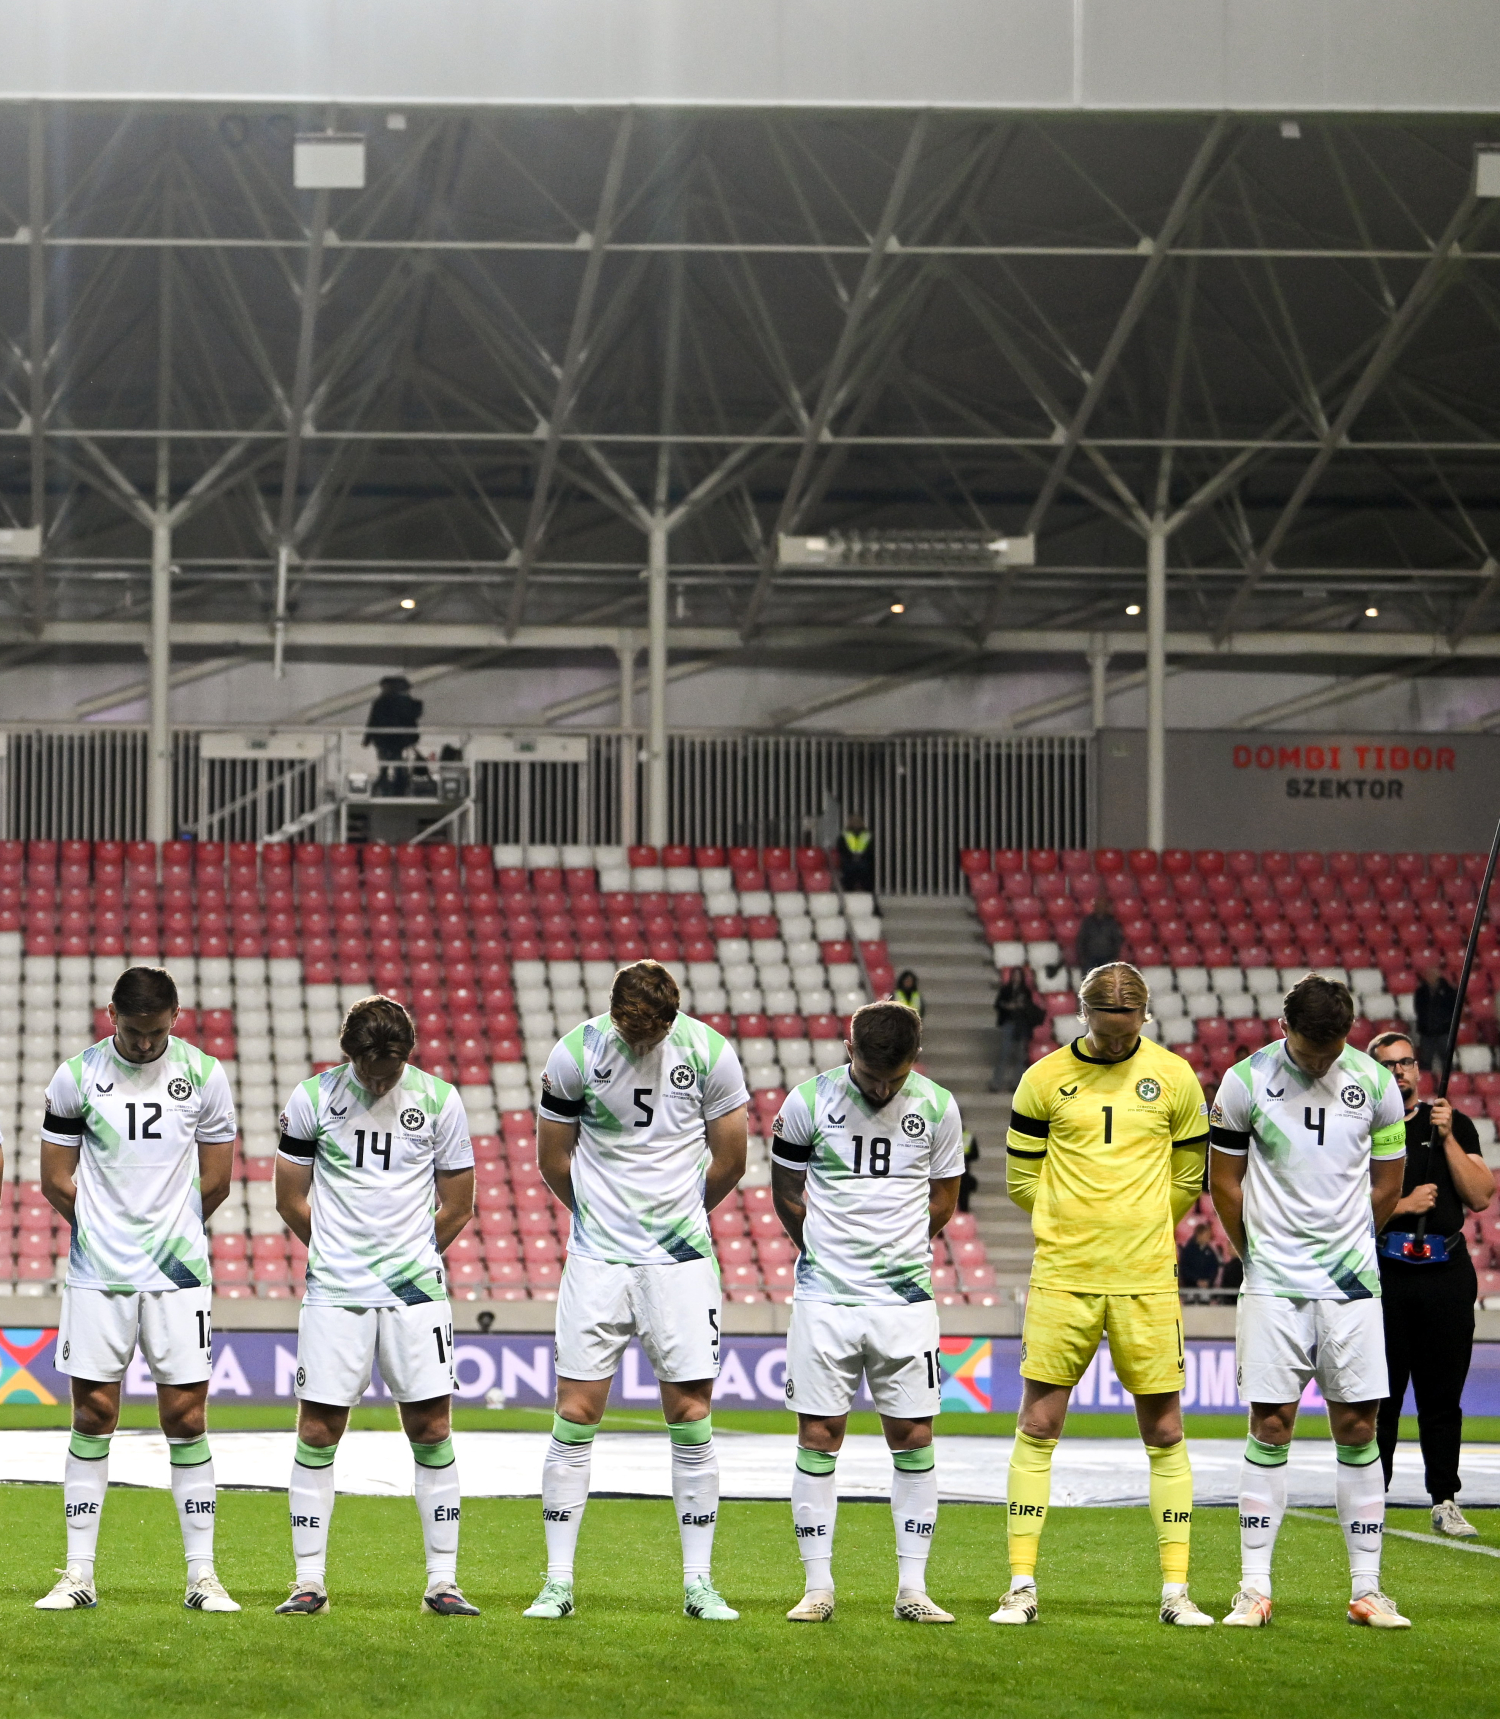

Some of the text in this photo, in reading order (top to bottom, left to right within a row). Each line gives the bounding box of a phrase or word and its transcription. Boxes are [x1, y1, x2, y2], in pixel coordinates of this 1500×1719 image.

[1232, 744, 1456, 771] DOMBI TIBOR
[1285, 777, 1405, 799] SZEKTOR
[633, 1088, 654, 1128] 5
[124, 1102, 163, 1141] 12
[1101, 1105, 1113, 1145] 1
[1304, 1106, 1326, 1146] 4
[353, 1129, 393, 1171] 14
[851, 1134, 892, 1176] 18
[66, 1502, 100, 1518] ÉIRE
[434, 1505, 460, 1522] ÉIR
[682, 1511, 716, 1526] ÉIRE
[1009, 1502, 1045, 1518] ÉIRE
[1163, 1509, 1193, 1523] ÉIR
[905, 1519, 936, 1535] ÉIR
